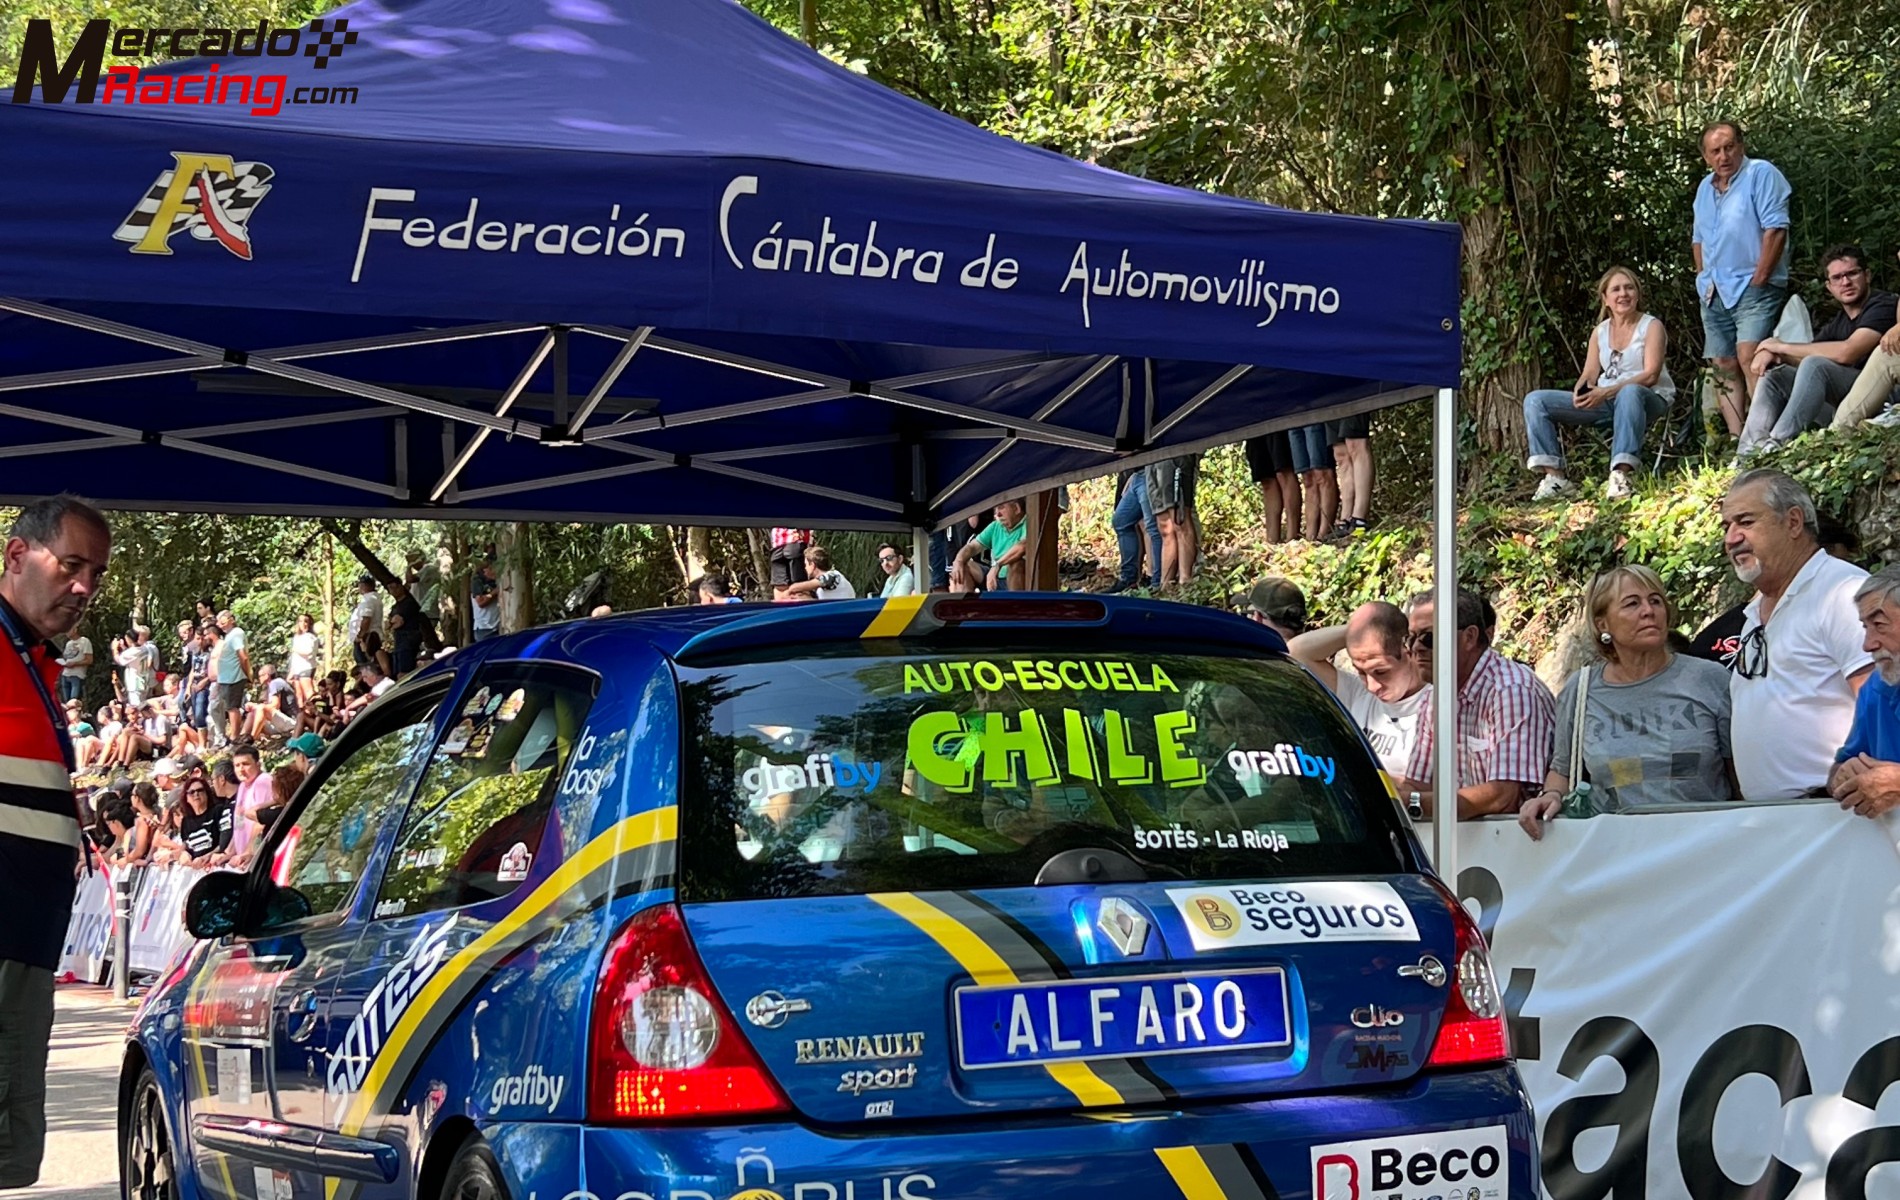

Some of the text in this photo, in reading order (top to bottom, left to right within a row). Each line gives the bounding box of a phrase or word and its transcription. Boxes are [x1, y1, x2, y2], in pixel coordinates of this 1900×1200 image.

[350, 175, 1340, 329] Federación Cántabra de Automovilismo
[903, 660, 1180, 695] AUTO-ESCUELA
[904, 707, 1207, 792] CHILE
[1227, 743, 1336, 786] grafiby
[742, 753, 882, 795] grafiby
[1214, 830, 1239, 849] La
[1241, 829, 1290, 853] Rioja
[1230, 889, 1306, 906] Beco
[1246, 903, 1405, 938] seguros
[1006, 979, 1247, 1055] ALFARO
[1350, 1003, 1405, 1029] Clio
[795, 1032, 926, 1064] RENAULT
[488, 1064, 565, 1115] grafiby
[836, 1063, 918, 1097] sport
[1371, 1145, 1501, 1191] Beco
